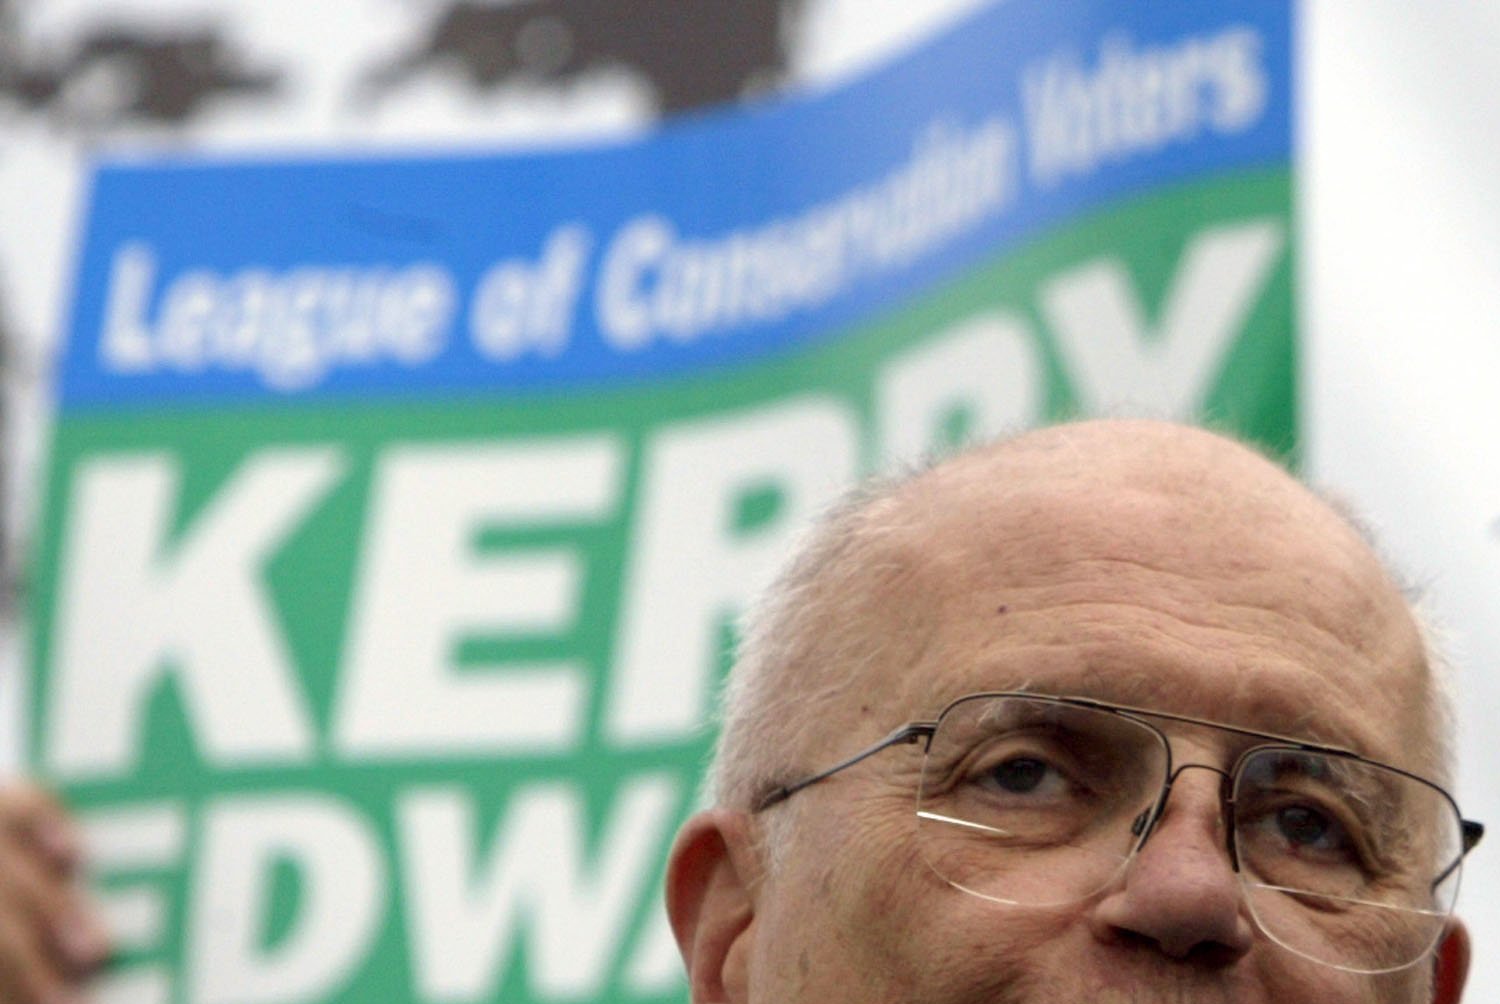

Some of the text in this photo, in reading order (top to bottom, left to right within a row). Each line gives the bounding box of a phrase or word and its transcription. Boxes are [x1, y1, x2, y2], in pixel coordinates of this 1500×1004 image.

[101, 26, 1268, 390] League of Conservation Voters
